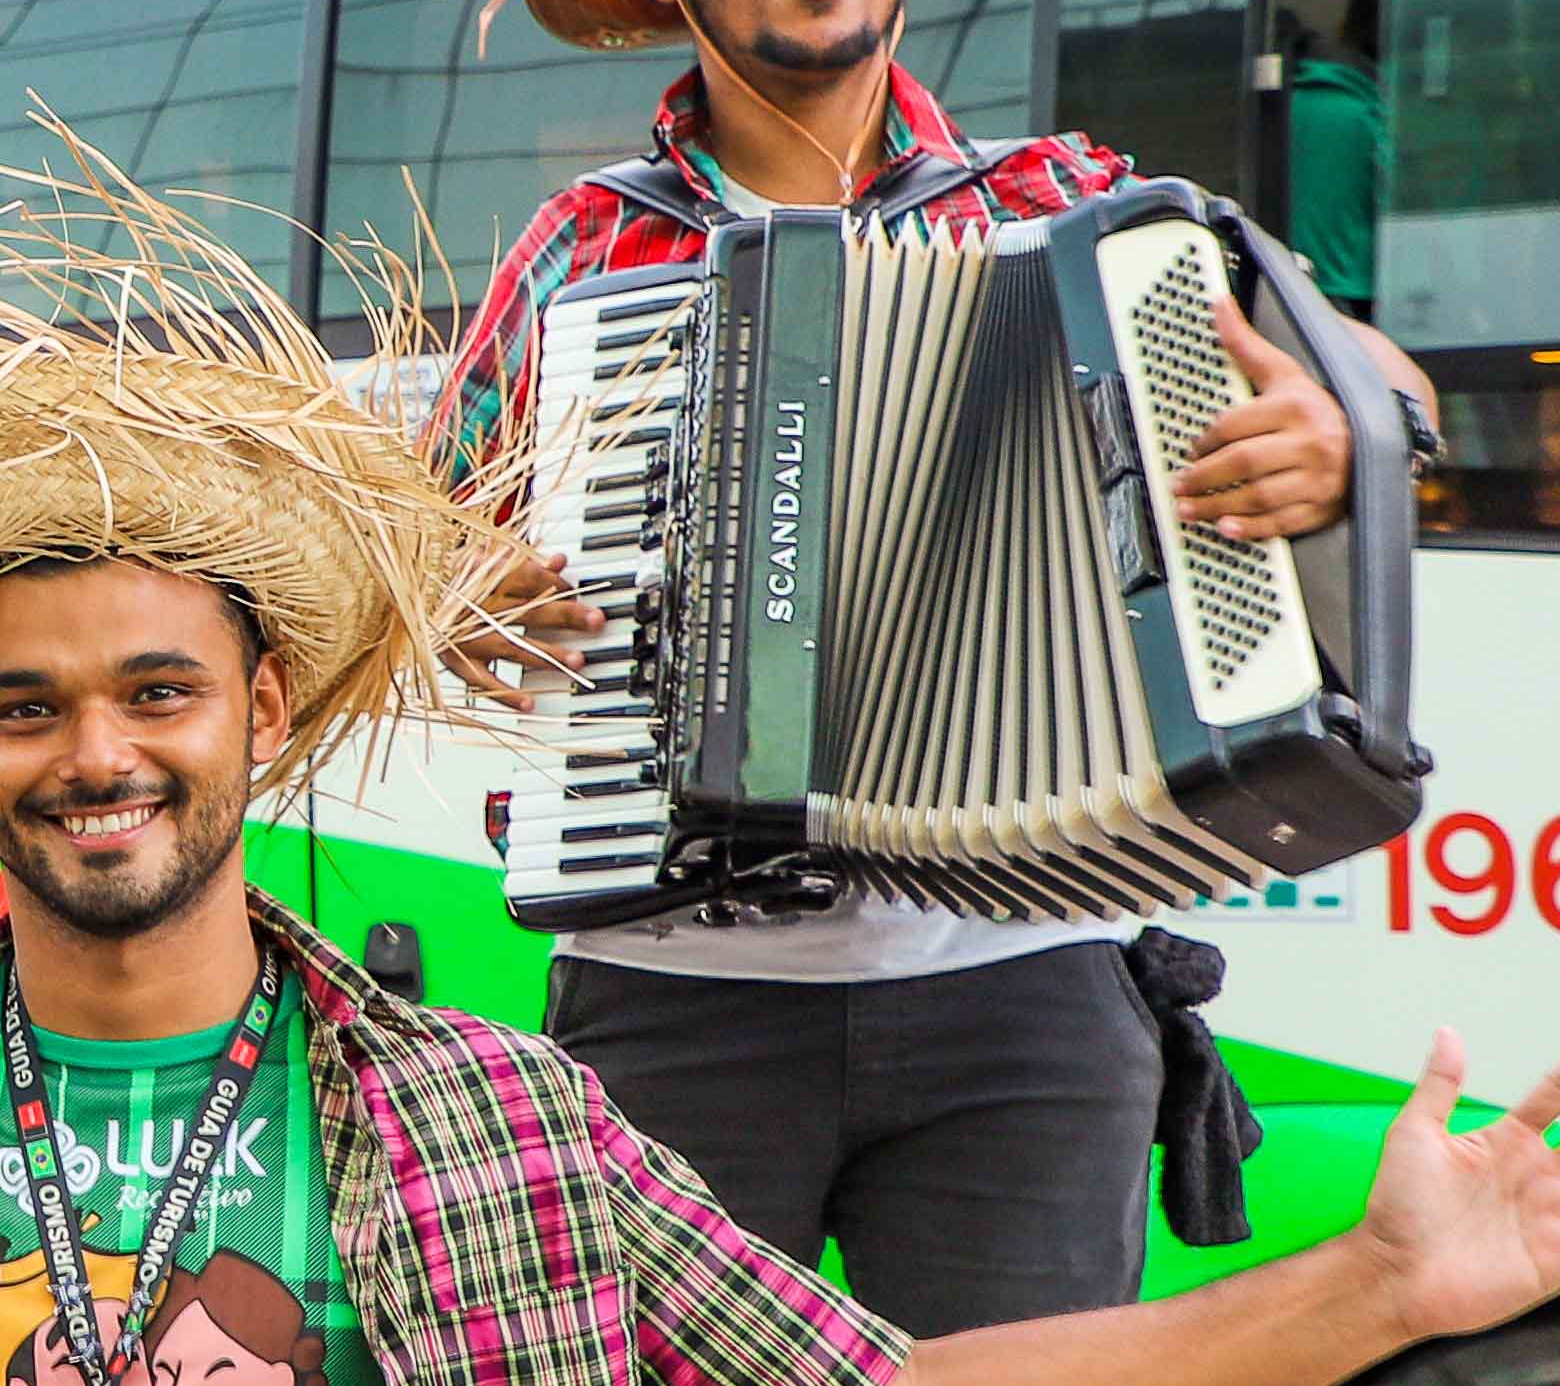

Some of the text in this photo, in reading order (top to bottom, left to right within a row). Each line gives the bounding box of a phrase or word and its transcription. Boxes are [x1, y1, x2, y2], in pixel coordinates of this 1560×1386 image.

[766, 401, 806, 623] SCANDALLI
[7, 1031, 34, 1089] GUIA
[197, 1078, 240, 1138] GUIA
[106, 1118, 268, 1178] LUK
[183, 1137, 215, 1175] DE
[116, 1183, 253, 1211] Rectivo
[39, 1184, 80, 1284] URISMO
[139, 1175, 199, 1285] TURISMO
